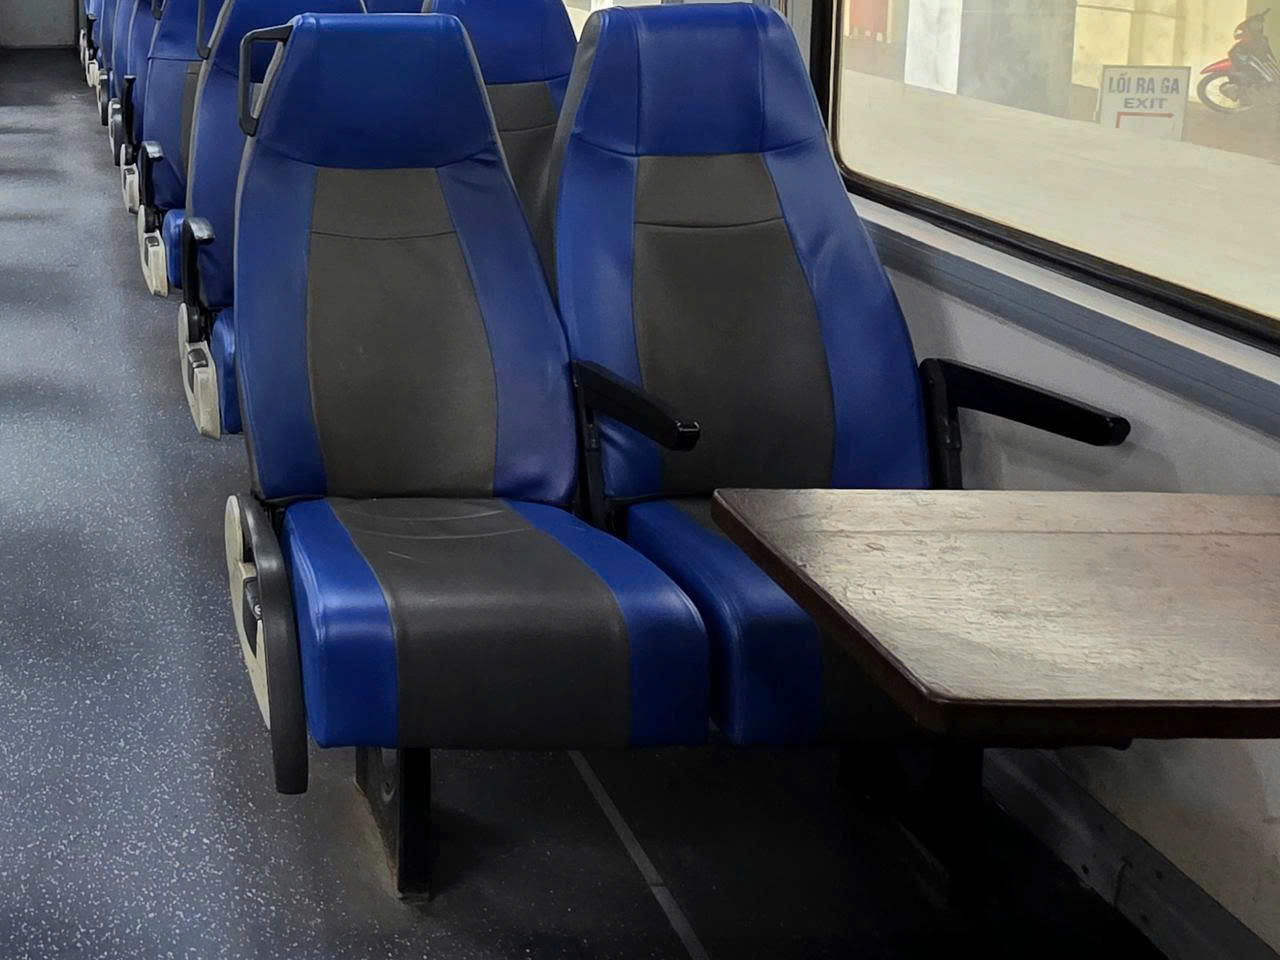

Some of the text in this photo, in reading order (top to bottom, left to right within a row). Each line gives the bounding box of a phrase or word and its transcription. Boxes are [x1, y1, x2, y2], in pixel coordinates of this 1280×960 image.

[1108, 71, 1180, 95] LỐI RA GA
[1123, 97, 1169, 109] EXIT
